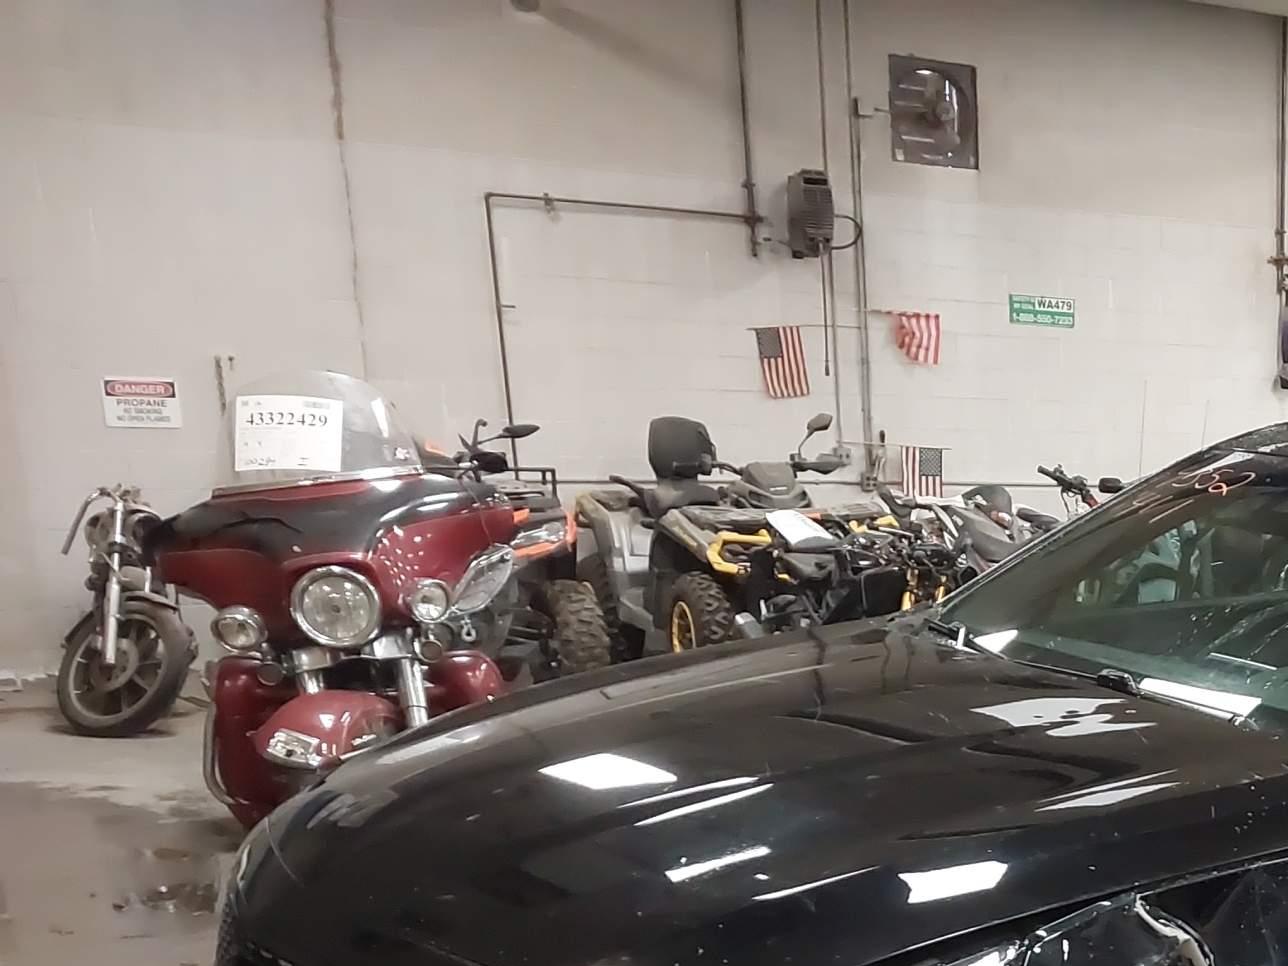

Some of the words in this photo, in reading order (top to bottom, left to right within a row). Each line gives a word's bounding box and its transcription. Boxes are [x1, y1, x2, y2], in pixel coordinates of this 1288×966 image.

[1037, 299, 1073, 312] WA479
[114, 383, 166, 395] DANGER
[116, 398, 168, 408] PROPANE
[246, 412, 328, 426] 43322429
